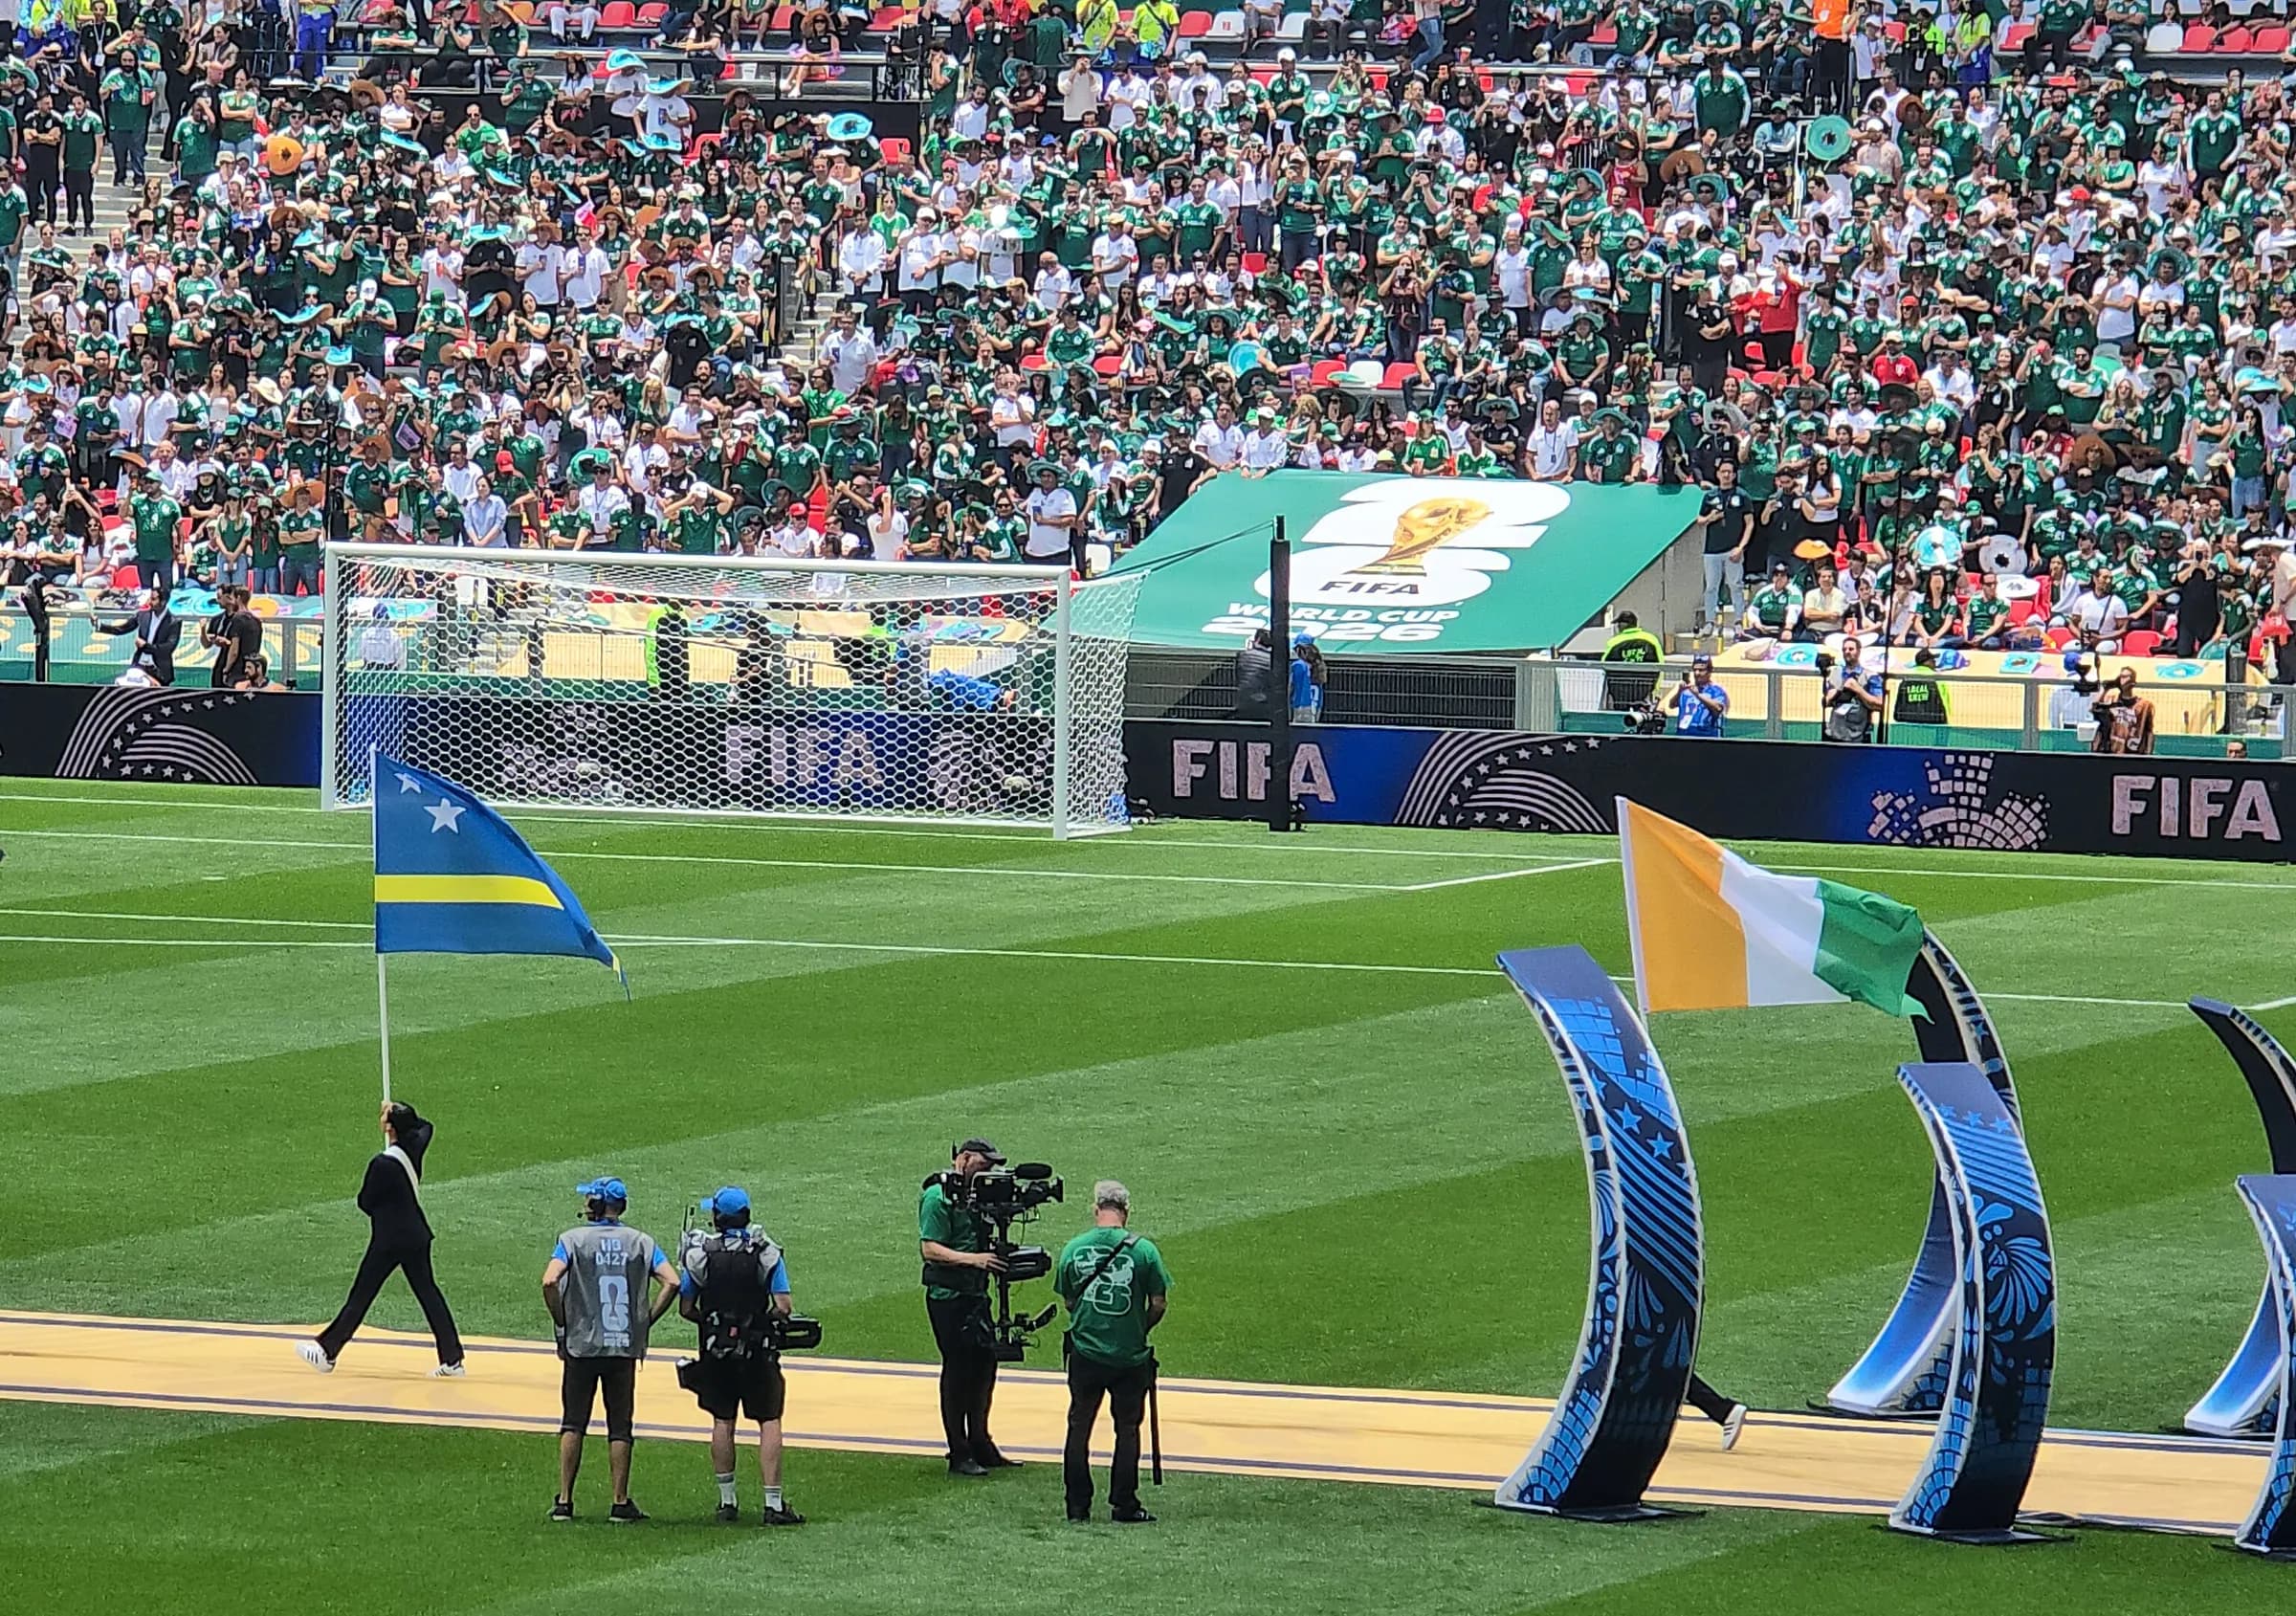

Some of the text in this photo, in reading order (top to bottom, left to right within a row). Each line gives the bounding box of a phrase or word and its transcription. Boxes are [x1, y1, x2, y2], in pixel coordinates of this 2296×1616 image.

[1318, 581, 1420, 594] FIFA
[1385, 609, 1460, 623] CUP
[726, 725, 883, 788] FIFA
[2112, 775, 2282, 841] FIFA
